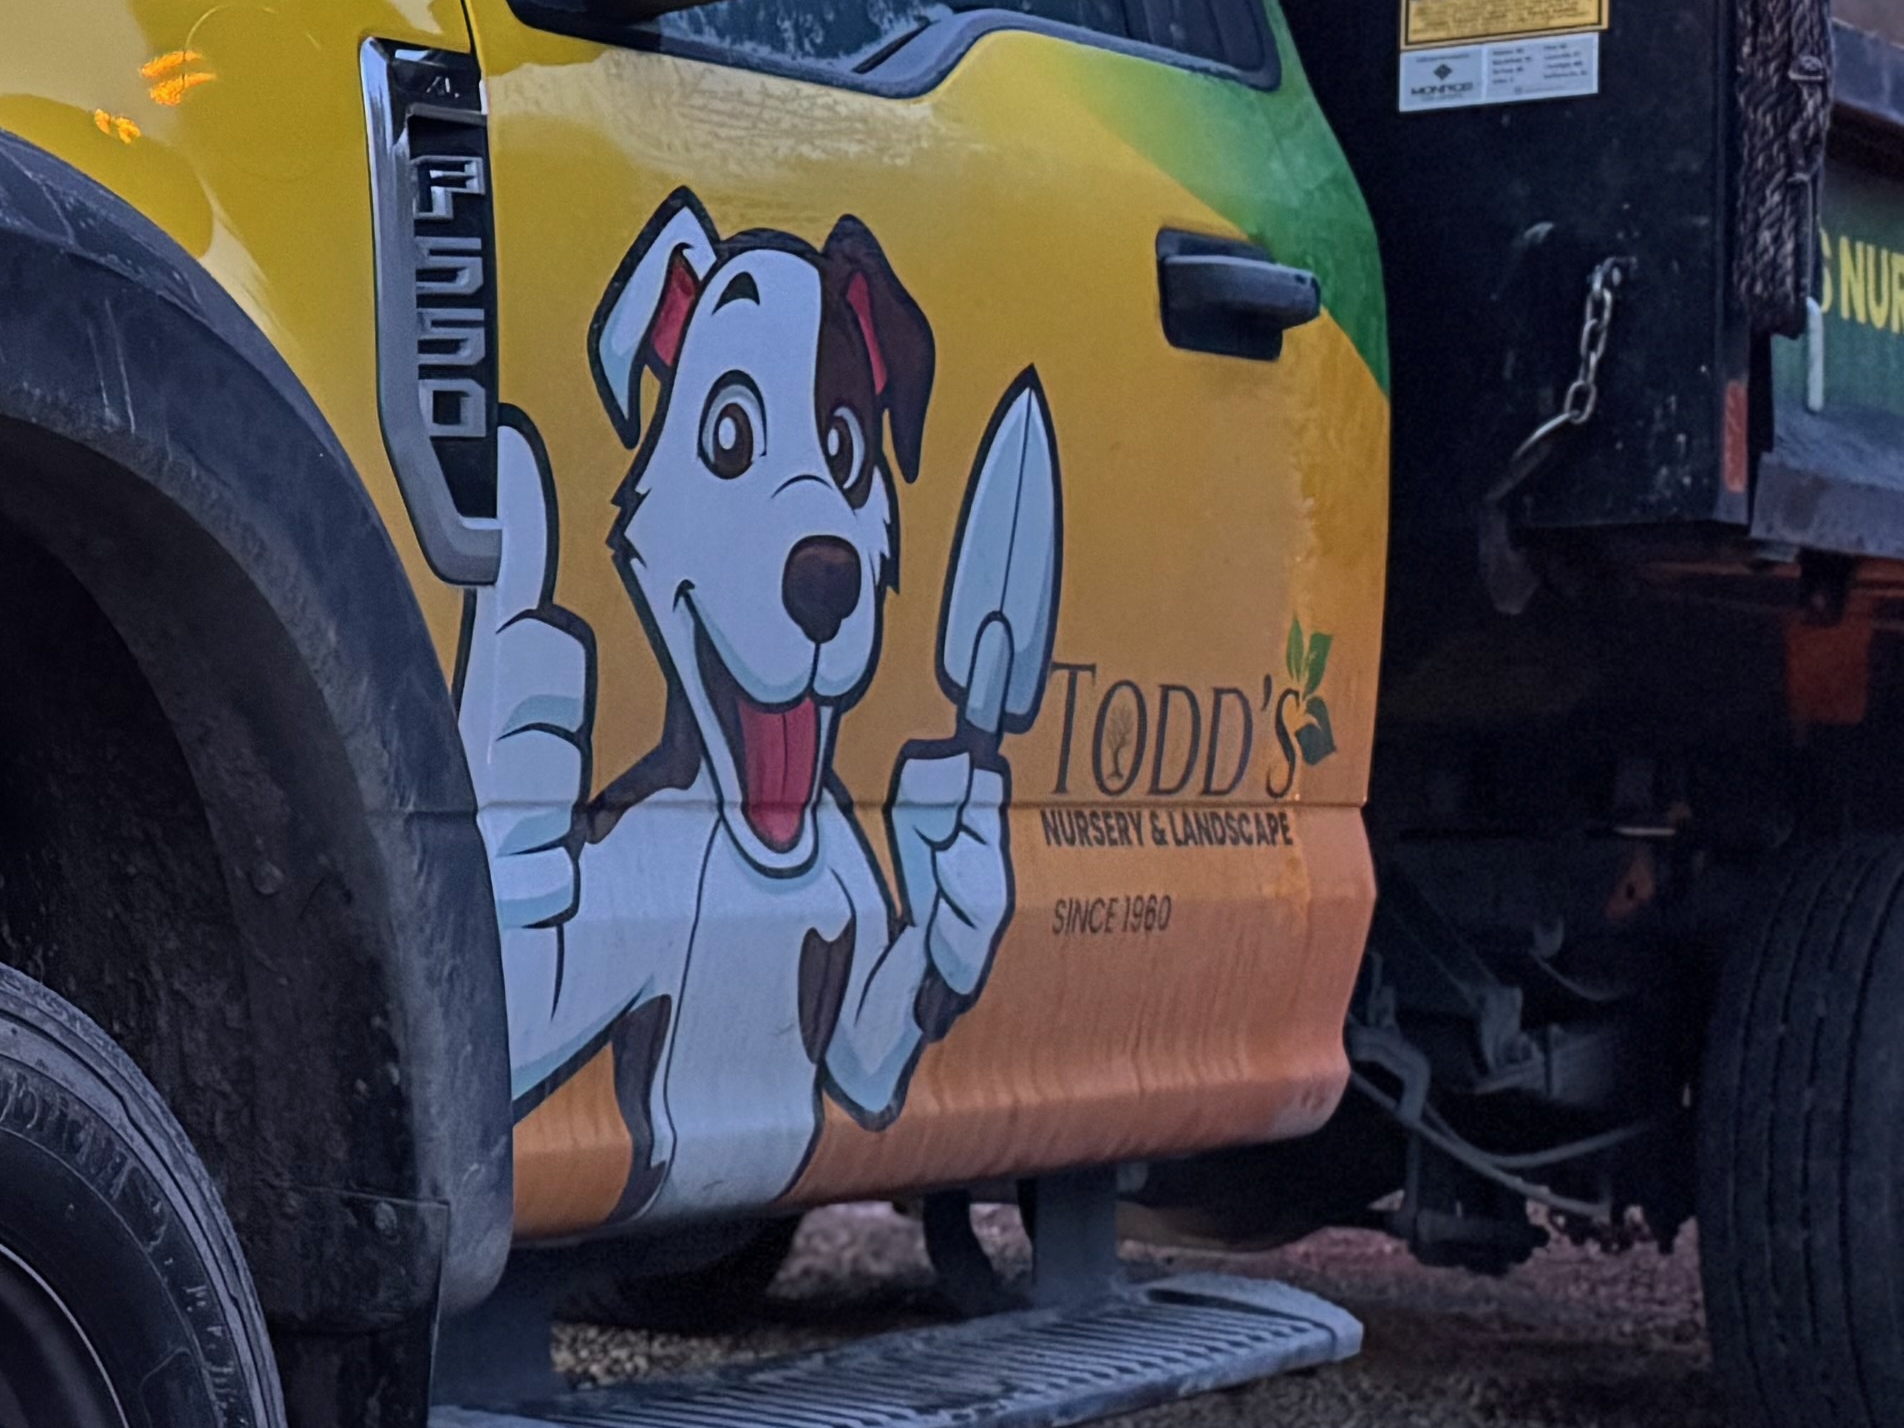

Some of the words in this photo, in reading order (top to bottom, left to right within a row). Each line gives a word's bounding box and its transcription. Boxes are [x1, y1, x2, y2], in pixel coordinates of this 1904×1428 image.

[412, 154, 486, 438] F550
[1050, 660, 1302, 800] TODD'S
[1040, 809, 1145, 847] NURSERY
[1149, 809, 1170, 847] &
[1169, 809, 1294, 847] LANDSCAPE
[1051, 896, 1119, 936] SINCE
[1121, 893, 1173, 933] 1960
